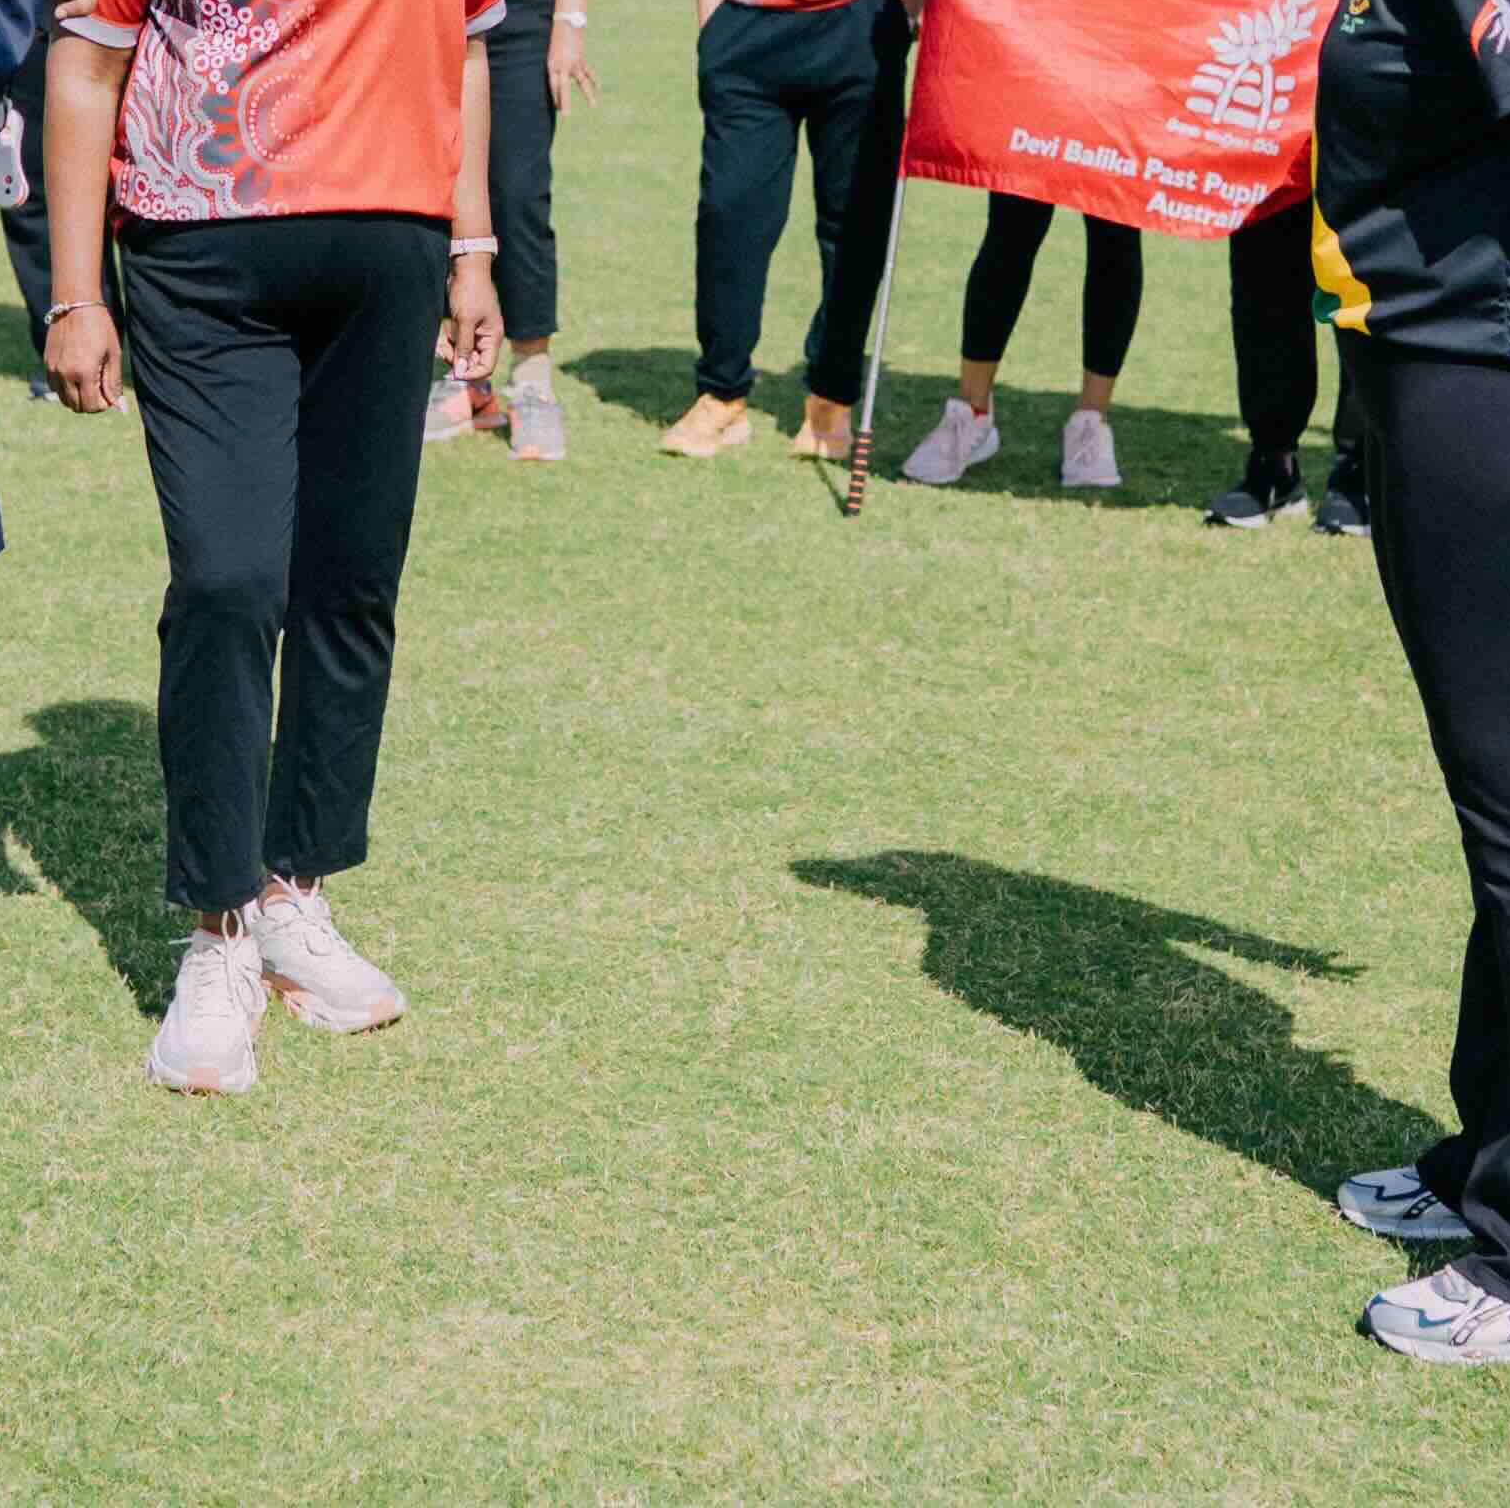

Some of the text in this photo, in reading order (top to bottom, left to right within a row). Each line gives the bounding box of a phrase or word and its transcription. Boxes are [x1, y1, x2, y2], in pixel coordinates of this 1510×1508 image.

[1009, 126, 1060, 159] Devi
[1062, 139, 1138, 178] Balika
[1143, 156, 1199, 191] Past
